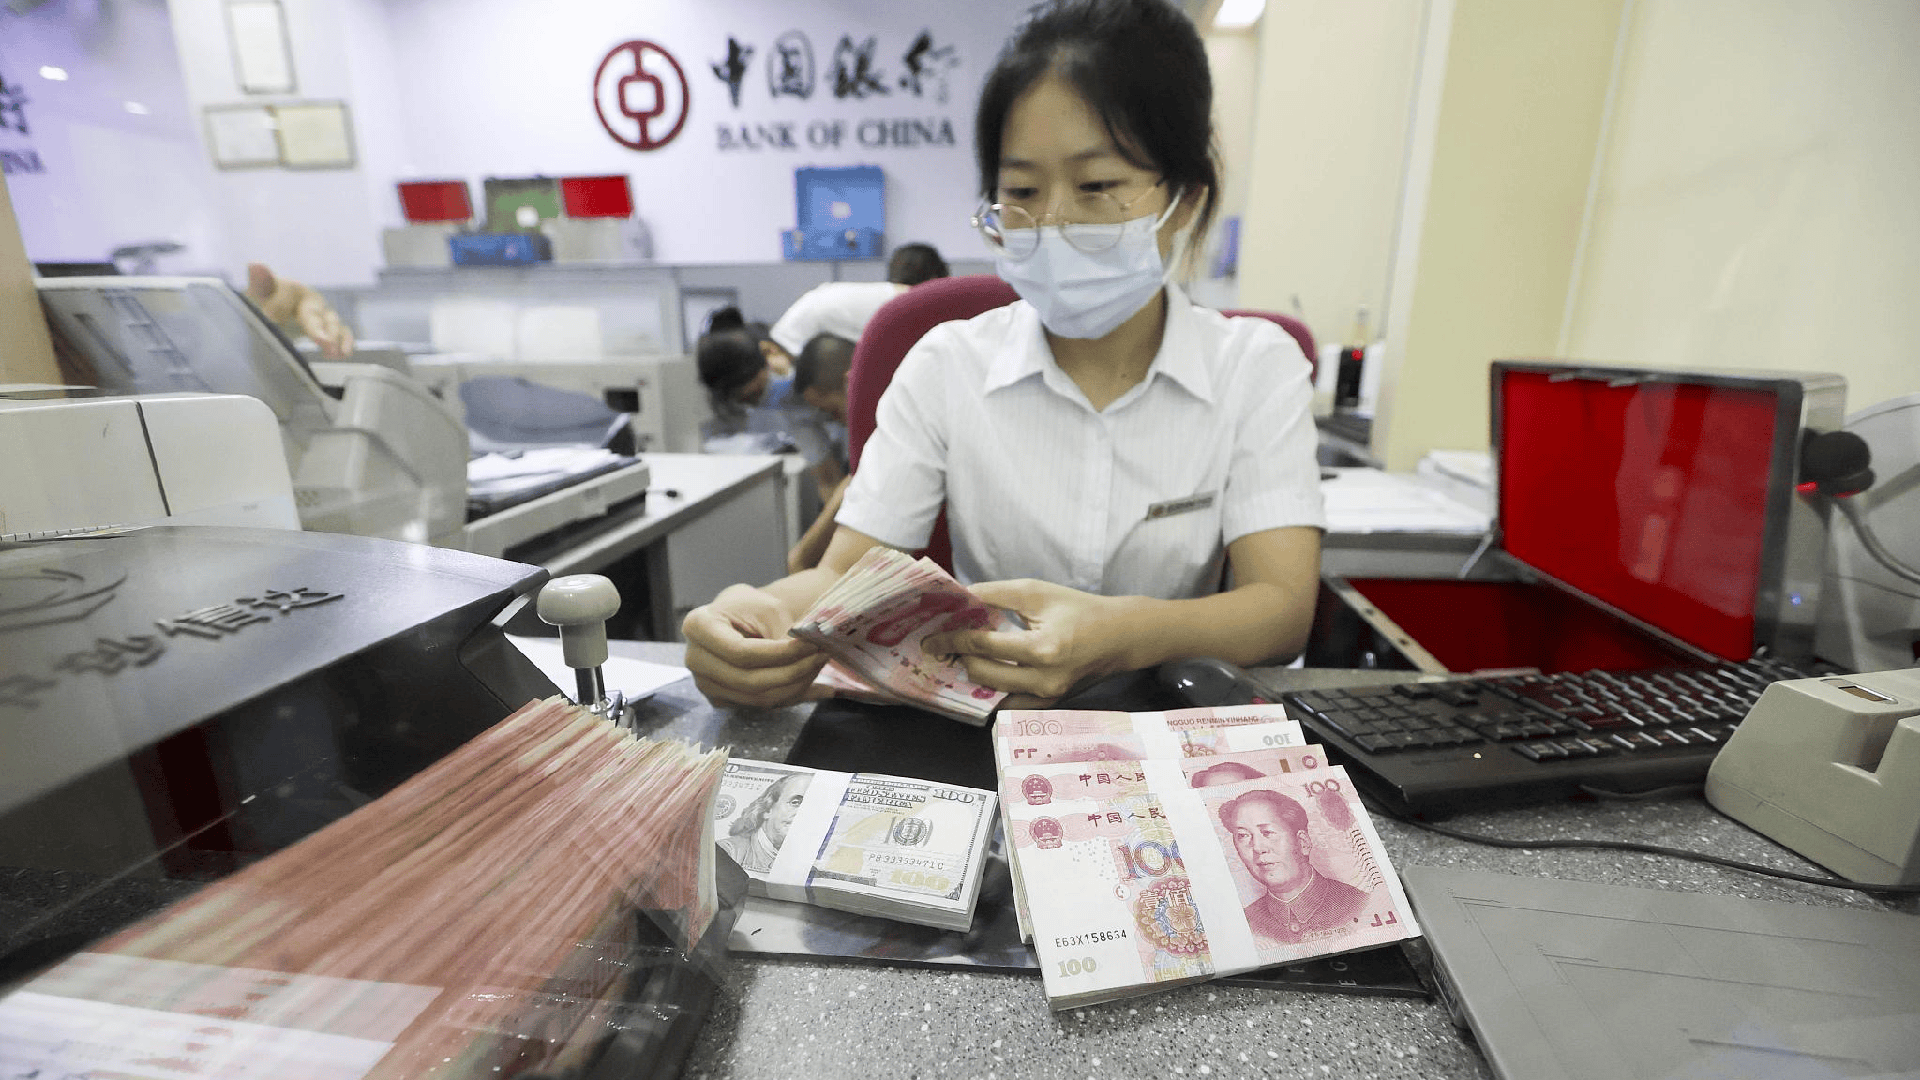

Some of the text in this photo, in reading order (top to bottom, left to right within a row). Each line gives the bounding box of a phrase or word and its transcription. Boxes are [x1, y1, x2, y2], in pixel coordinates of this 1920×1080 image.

[716, 116, 955, 148] BANK OF CHINA
[1018, 719, 1063, 736] 100
[932, 787, 975, 804] 100
[1304, 778, 1341, 798] 100
[1087, 807, 1167, 828] 中国人民
[889, 868, 951, 891] 100
[1055, 928, 1128, 948] E63X158634
[1057, 956, 1097, 978] 100
